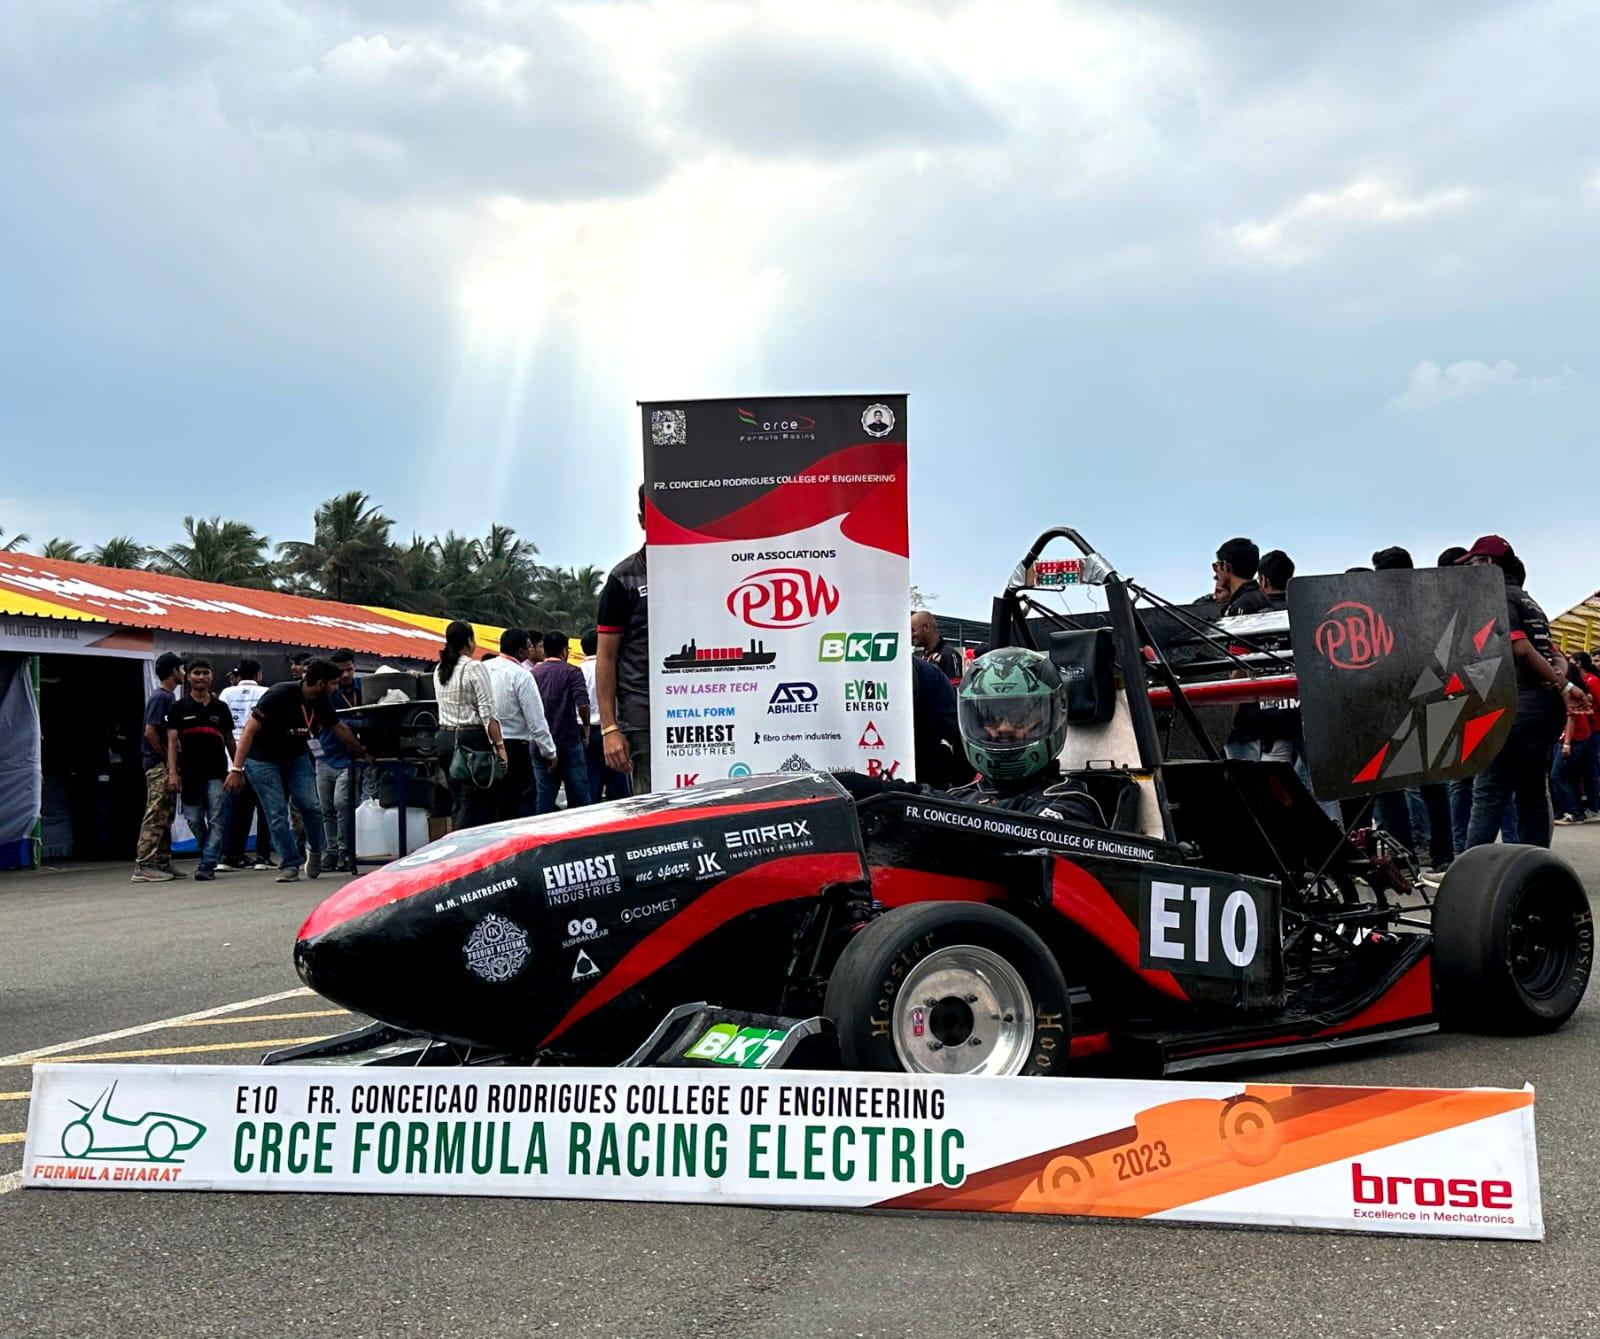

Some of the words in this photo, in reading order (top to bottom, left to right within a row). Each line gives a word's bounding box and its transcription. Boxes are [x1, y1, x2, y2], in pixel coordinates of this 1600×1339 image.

[763, 420, 798, 431] crce
[653, 481, 668, 490] FR.
[669, 479, 721, 490] CONCEICAO
[722, 476, 776, 487] RODRIGUES
[776, 475, 817, 484] COLLEGE
[818, 474, 831, 483] OF
[832, 473, 896, 483] ENGINEERING
[731, 552, 755, 562] OUR
[757, 549, 836, 561] ASSOCIATIONS
[727, 567, 840, 630] PBW
[1315, 601, 1394, 670] PBW
[820, 635, 897, 660] BKT
[665, 685, 688, 695] SVN
[690, 683, 727, 694] LASER
[730, 682, 758, 692] TECH
[666, 708, 701, 718] METAL
[703, 707, 735, 717] FORM
[767, 703, 819, 714] ABHIJEET
[845, 701, 889, 712] ENERGY
[666, 725, 735, 743] EVEREST
[763, 733, 780, 742] fibro
[782, 733, 803, 741] chem
[804, 731, 842, 741] industries
[666, 747, 736, 757] INDUSTRIES
[724, 820, 811, 849] EMRAX
[906, 805, 922, 819] FR.
[923, 808, 982, 829] CONCEICAO
[983, 819, 1038, 841] RODRIGUES
[1039, 829, 1082, 848] COLLEGE
[1083, 838, 1096, 850] OF
[1096, 839, 1154, 861] ENGINEERING
[626, 840, 690, 860] EDUSSPHERE
[729, 846, 776, 860] INNOVATIVE
[542, 854, 618, 889] EVEREST
[697, 851, 722, 875] JK
[434, 897, 460, 913] M.M.
[460, 877, 519, 904] HEATREATERS
[549, 882, 622, 907] INDUSTRIES
[632, 898, 678, 919] COMET
[590, 928, 609, 941] GEAR
[1149, 880, 1259, 968] E10
[688, 1028, 785, 1066] BKT
[236, 1085, 278, 1115] E10
[307, 1084, 341, 1114] FR.
[350, 1083, 478, 1114] CONCEICAO
[487, 1083, 616, 1115] RODRIGUES
[626, 1084, 730, 1115] COLLEGE
[740, 1085, 768, 1115] OF
[779, 1086, 946, 1120] ENGINEERING
[233, 1121, 337, 1174] CRCE
[351, 1121, 548, 1176] FORMULA
[567, 1121, 728, 1179] RACING
[748, 1123, 967, 1187] ELECTRIC
[1113, 1140, 1172, 1182] 2023
[33, 1164, 113, 1181] FORMULA
[113, 1166, 182, 1182] BHARAT
[1352, 1162, 1514, 1210] brose
[1353, 1208, 1417, 1221] Excellence
[1419, 1209, 1432, 1222] in
[1433, 1210, 1515, 1225] Mechatronics
